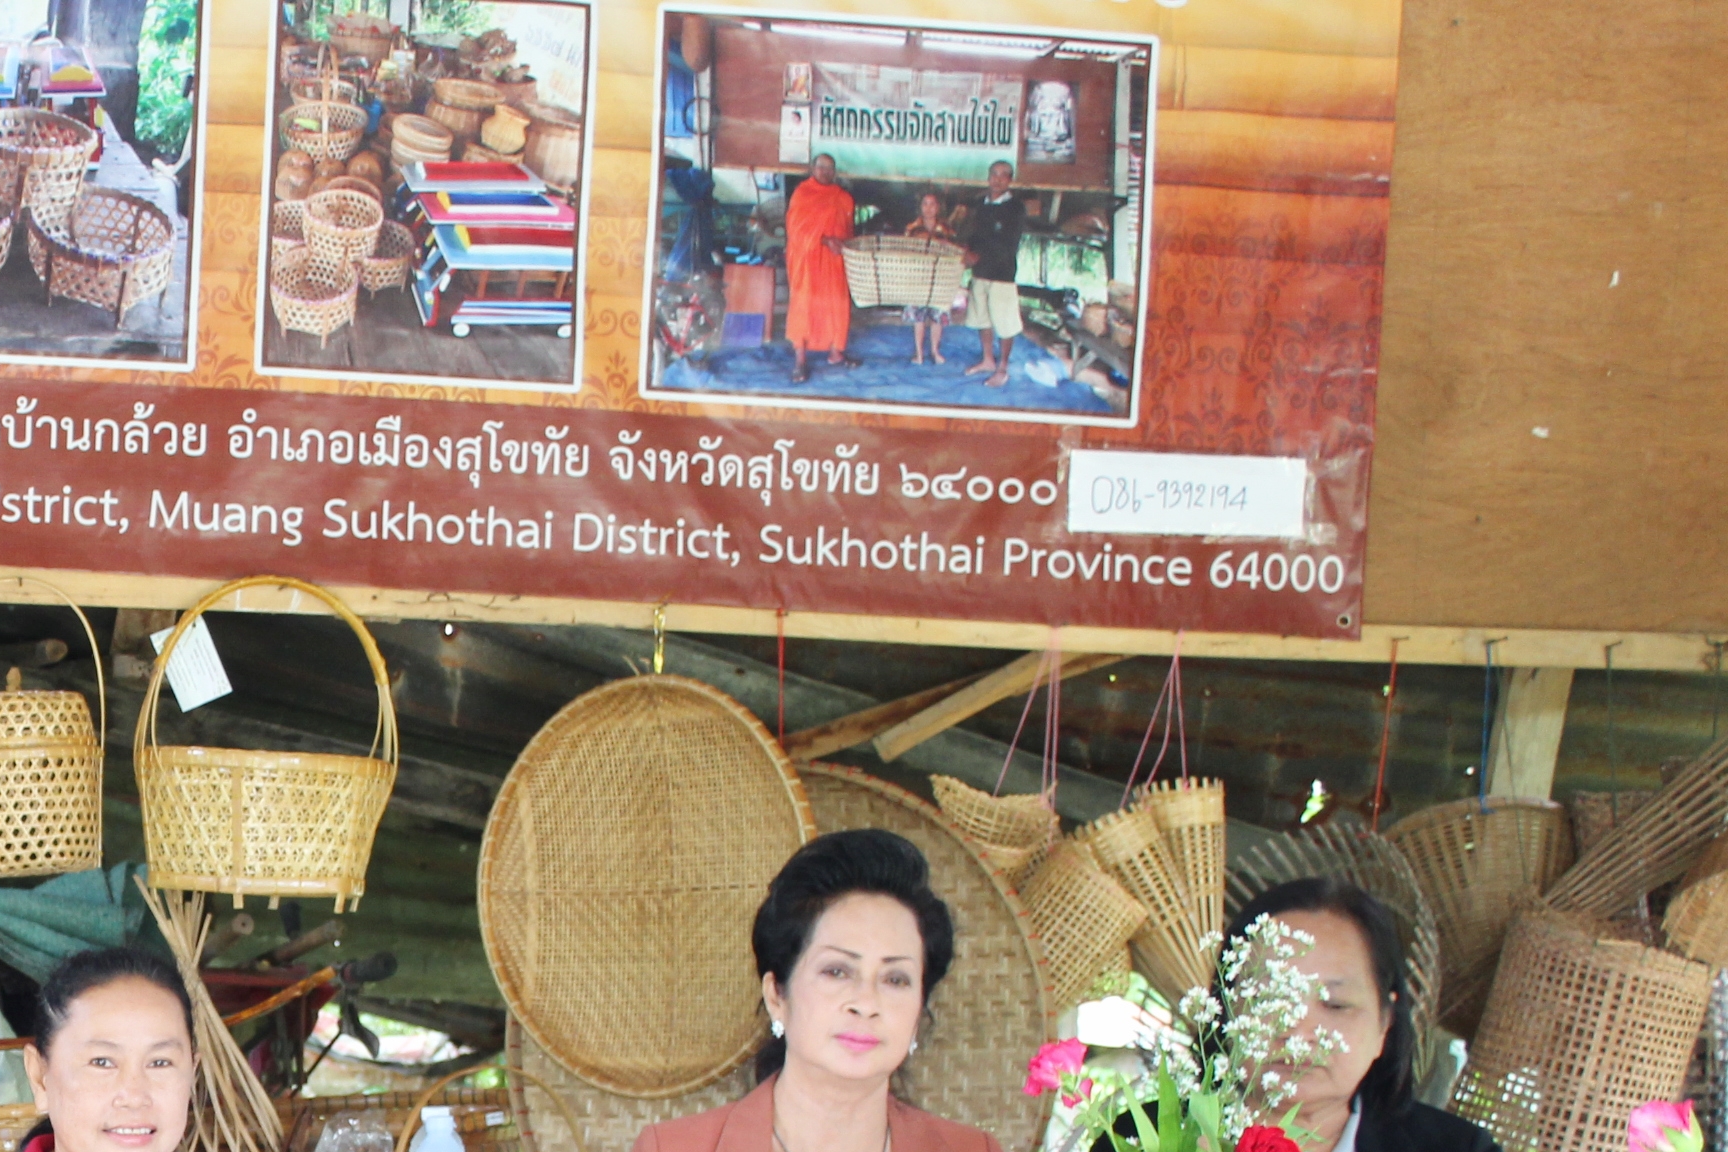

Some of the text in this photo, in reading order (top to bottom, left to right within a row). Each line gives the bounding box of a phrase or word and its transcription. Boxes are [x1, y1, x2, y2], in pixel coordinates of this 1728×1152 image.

[227, 408, 590, 490] อำเภอเมืองสุโขทัย
[608, 429, 880, 508] จังหวัดสุโขทัย
[899, 462, 1059, 507] ๖๔๐๐๐
[1090, 475, 1248, 515] 086-9392194
[148, 489, 305, 547] Muang
[322, 497, 555, 551] Sukhothai
[572, 507, 741, 568] District,
[759, 522, 985, 576] Sukhothai
[1002, 522, 1193, 588] Province
[1209, 549, 1346, 595] 64000
